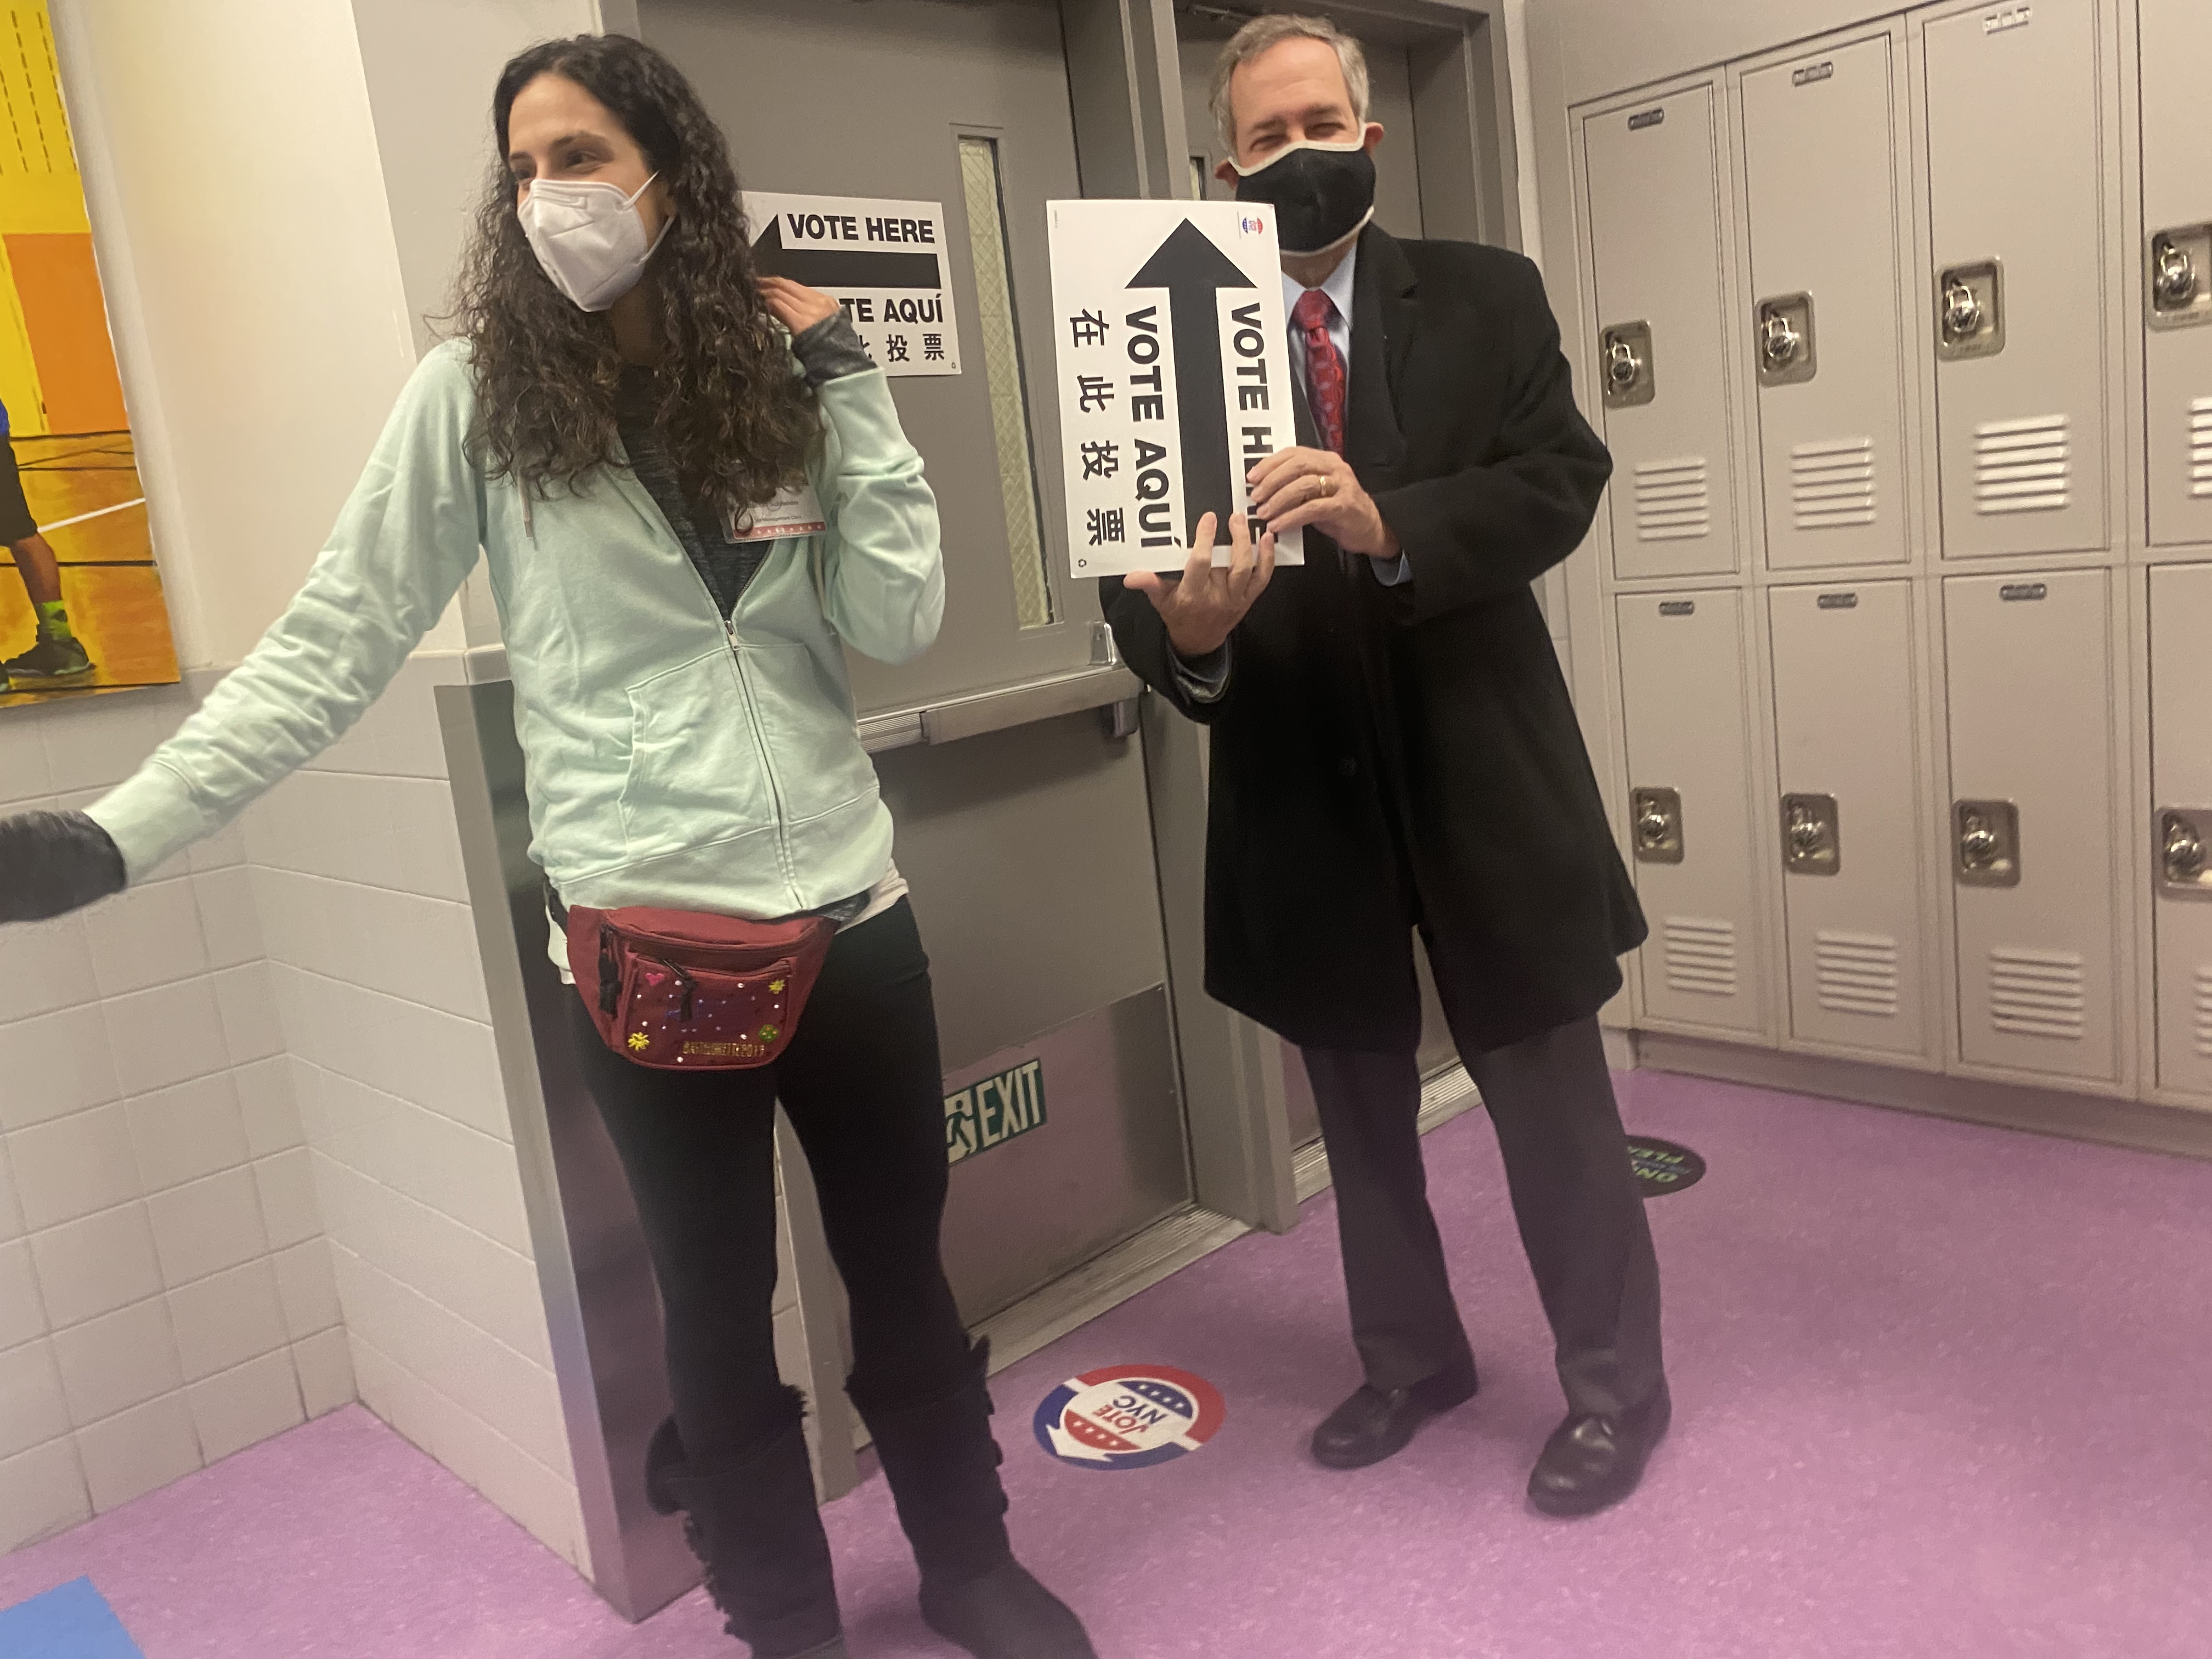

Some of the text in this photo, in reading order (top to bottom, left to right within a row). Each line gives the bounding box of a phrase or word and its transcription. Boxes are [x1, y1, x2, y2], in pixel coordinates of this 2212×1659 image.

[787, 213, 935, 244] VOTE HERE
[839, 294, 944, 324] TE AQUÍ
[1231, 302, 1270, 411] VOTE
[1070, 308, 1125, 546] 在此投票
[1125, 306, 1182, 549] VOTE AQUÍ
[975, 1060, 1040, 1147] EXIT
[1092, 1404, 1149, 1435] VOTE
[1112, 1395, 1168, 1425] NYC
